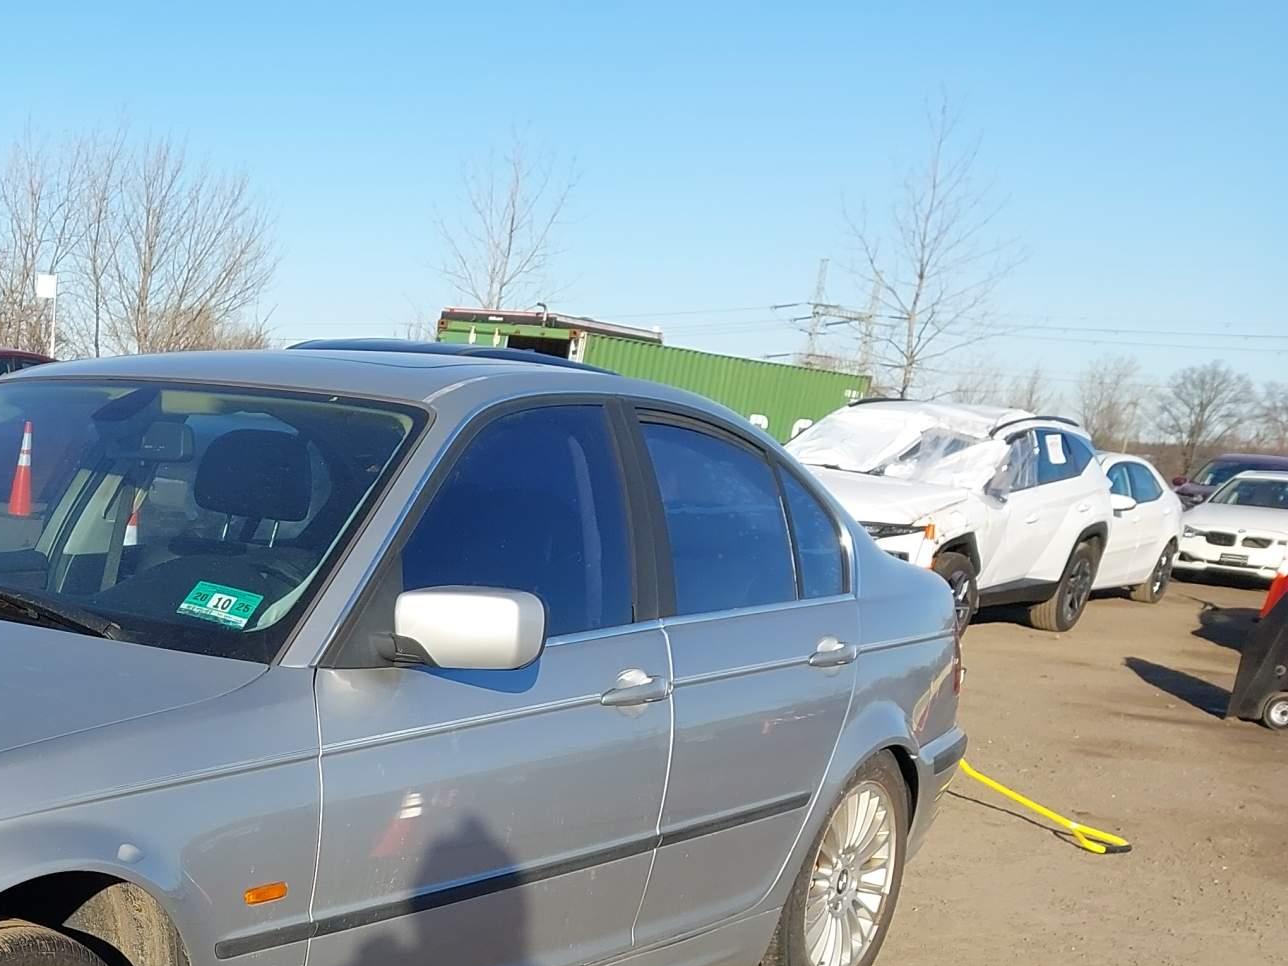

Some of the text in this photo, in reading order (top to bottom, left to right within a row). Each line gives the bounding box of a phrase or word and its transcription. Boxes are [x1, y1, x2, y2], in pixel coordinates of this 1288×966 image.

[193, 592, 250, 612] 20 10 25
